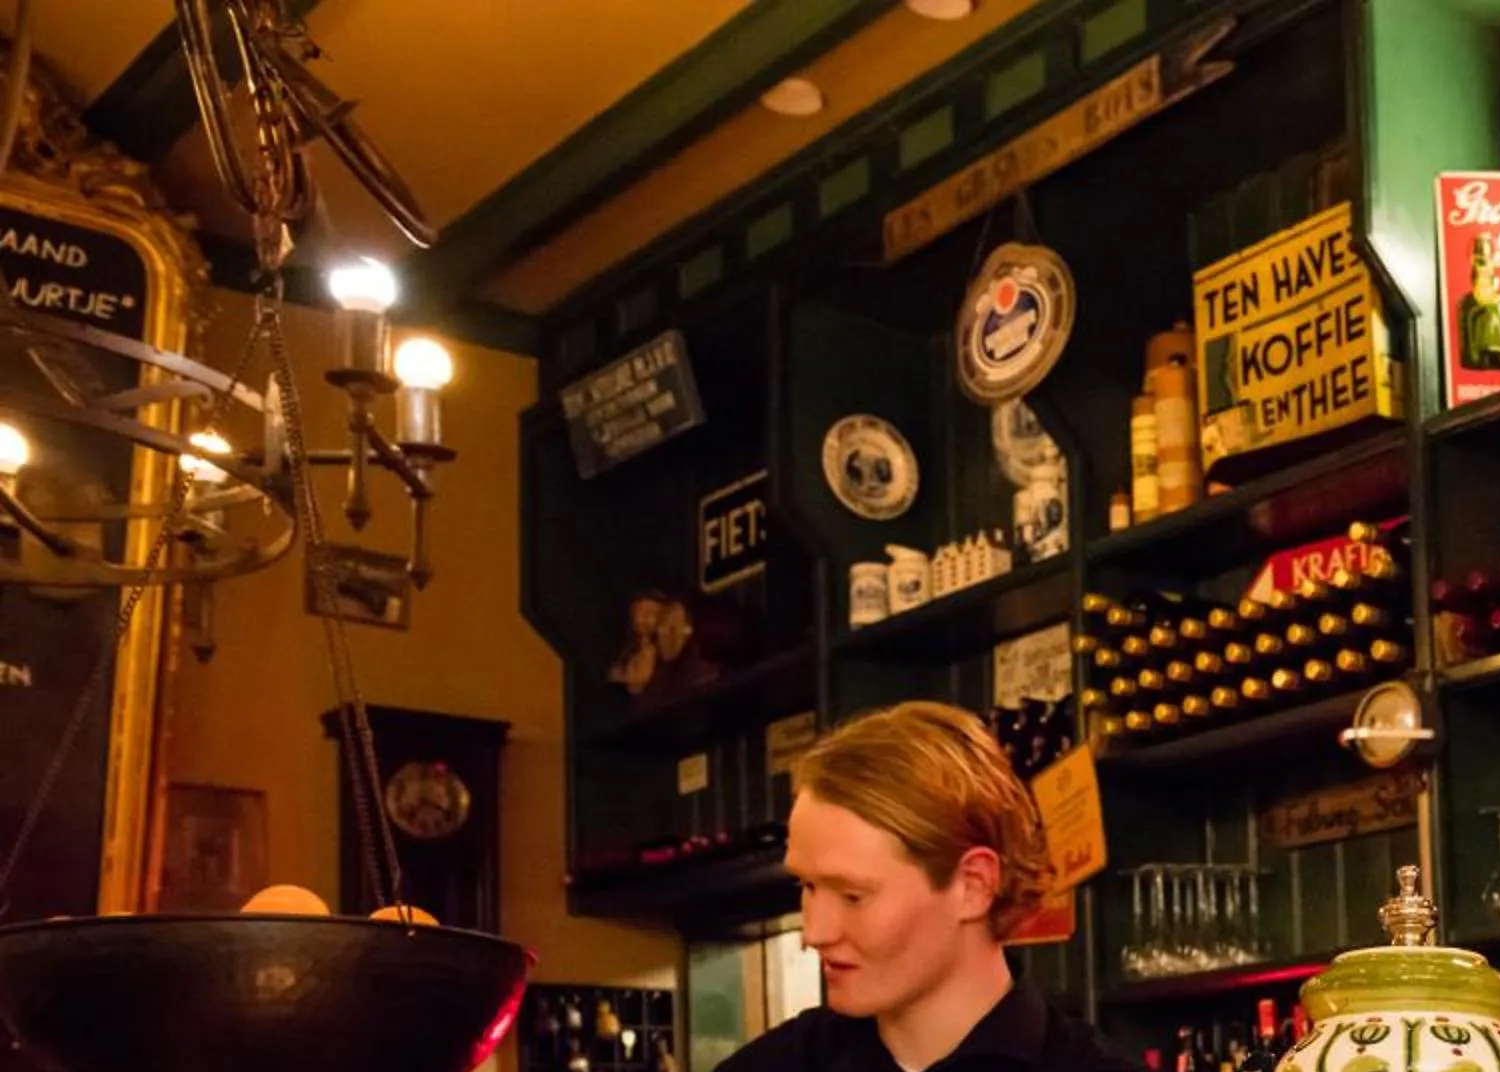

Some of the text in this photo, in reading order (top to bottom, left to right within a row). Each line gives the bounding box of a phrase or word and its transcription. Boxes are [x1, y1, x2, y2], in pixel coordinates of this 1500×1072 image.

[1203, 271, 1261, 330] TEN
[1240, 294, 1367, 387] KOFFIE
[1291, 355, 1370, 427] THEE
[704, 499, 768, 565] FIET
